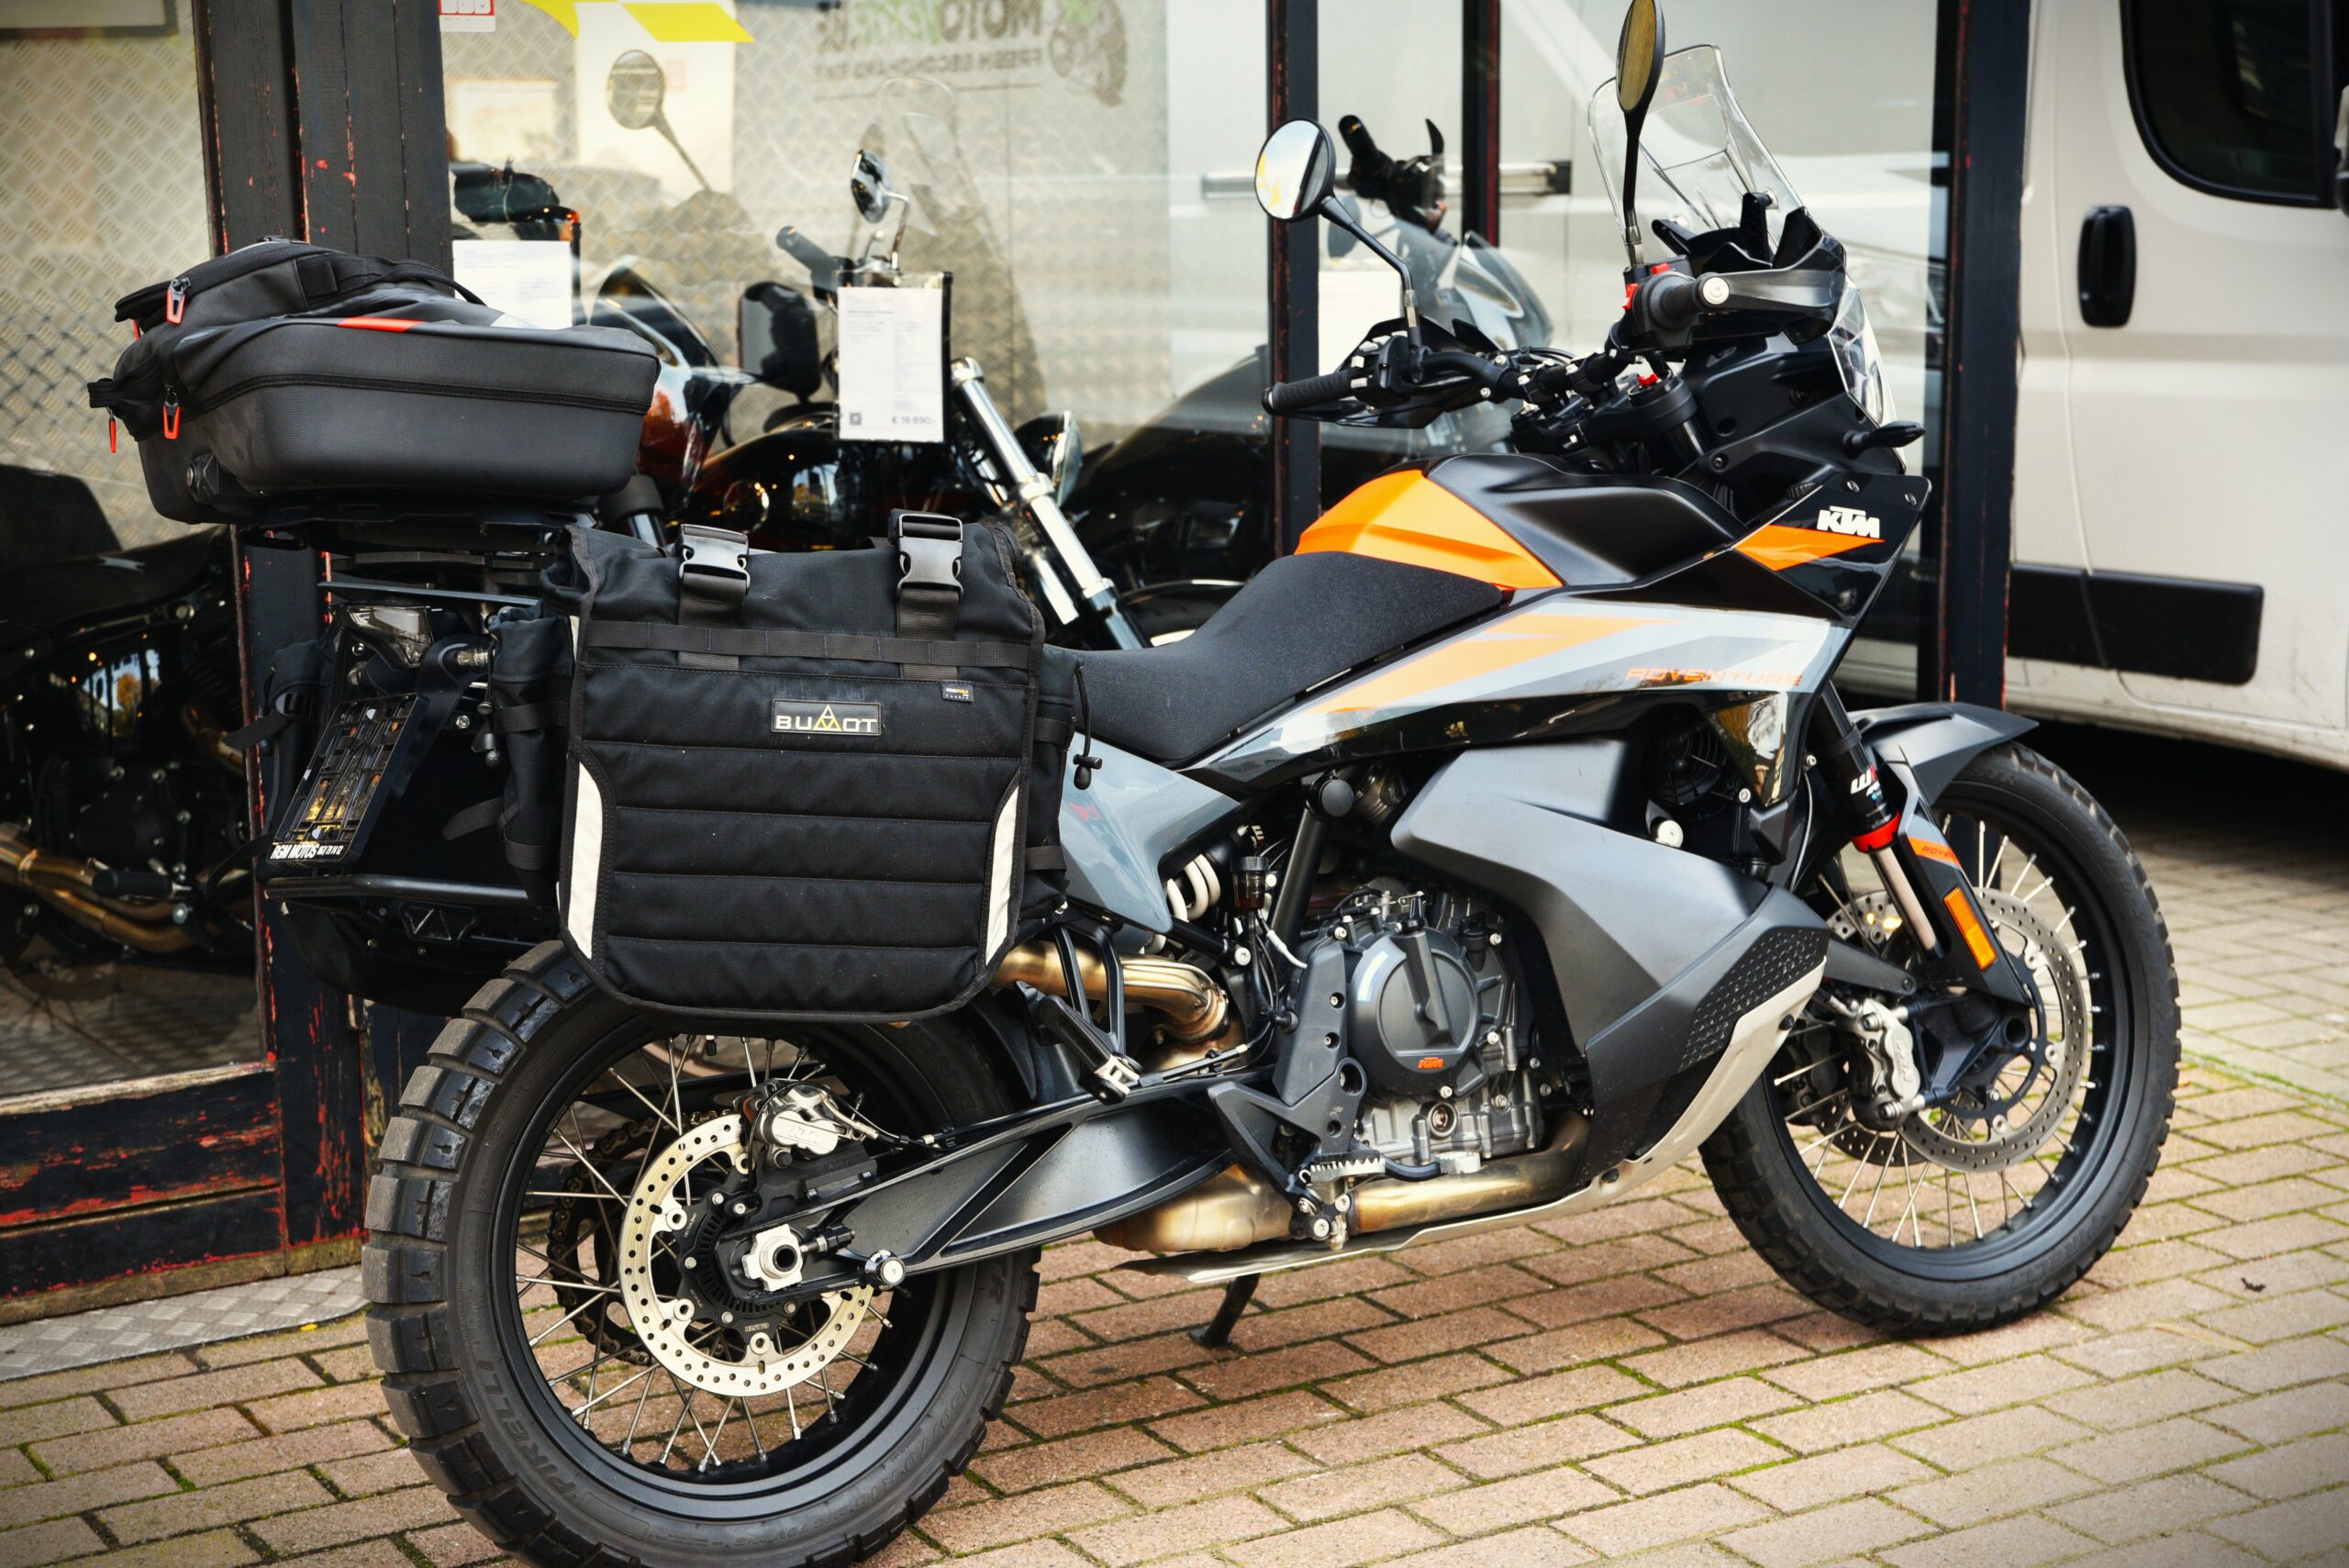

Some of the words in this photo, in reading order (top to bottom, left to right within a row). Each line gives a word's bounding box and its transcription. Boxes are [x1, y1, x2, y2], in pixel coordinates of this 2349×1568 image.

[1816, 506, 1880, 539] KTM
[1625, 667, 1803, 687] ADVENTURE
[287, 843, 319, 859] MOTOS
[1418, 1056, 1444, 1070] KTM
[475, 1355, 578, 1499] PIRELLI
